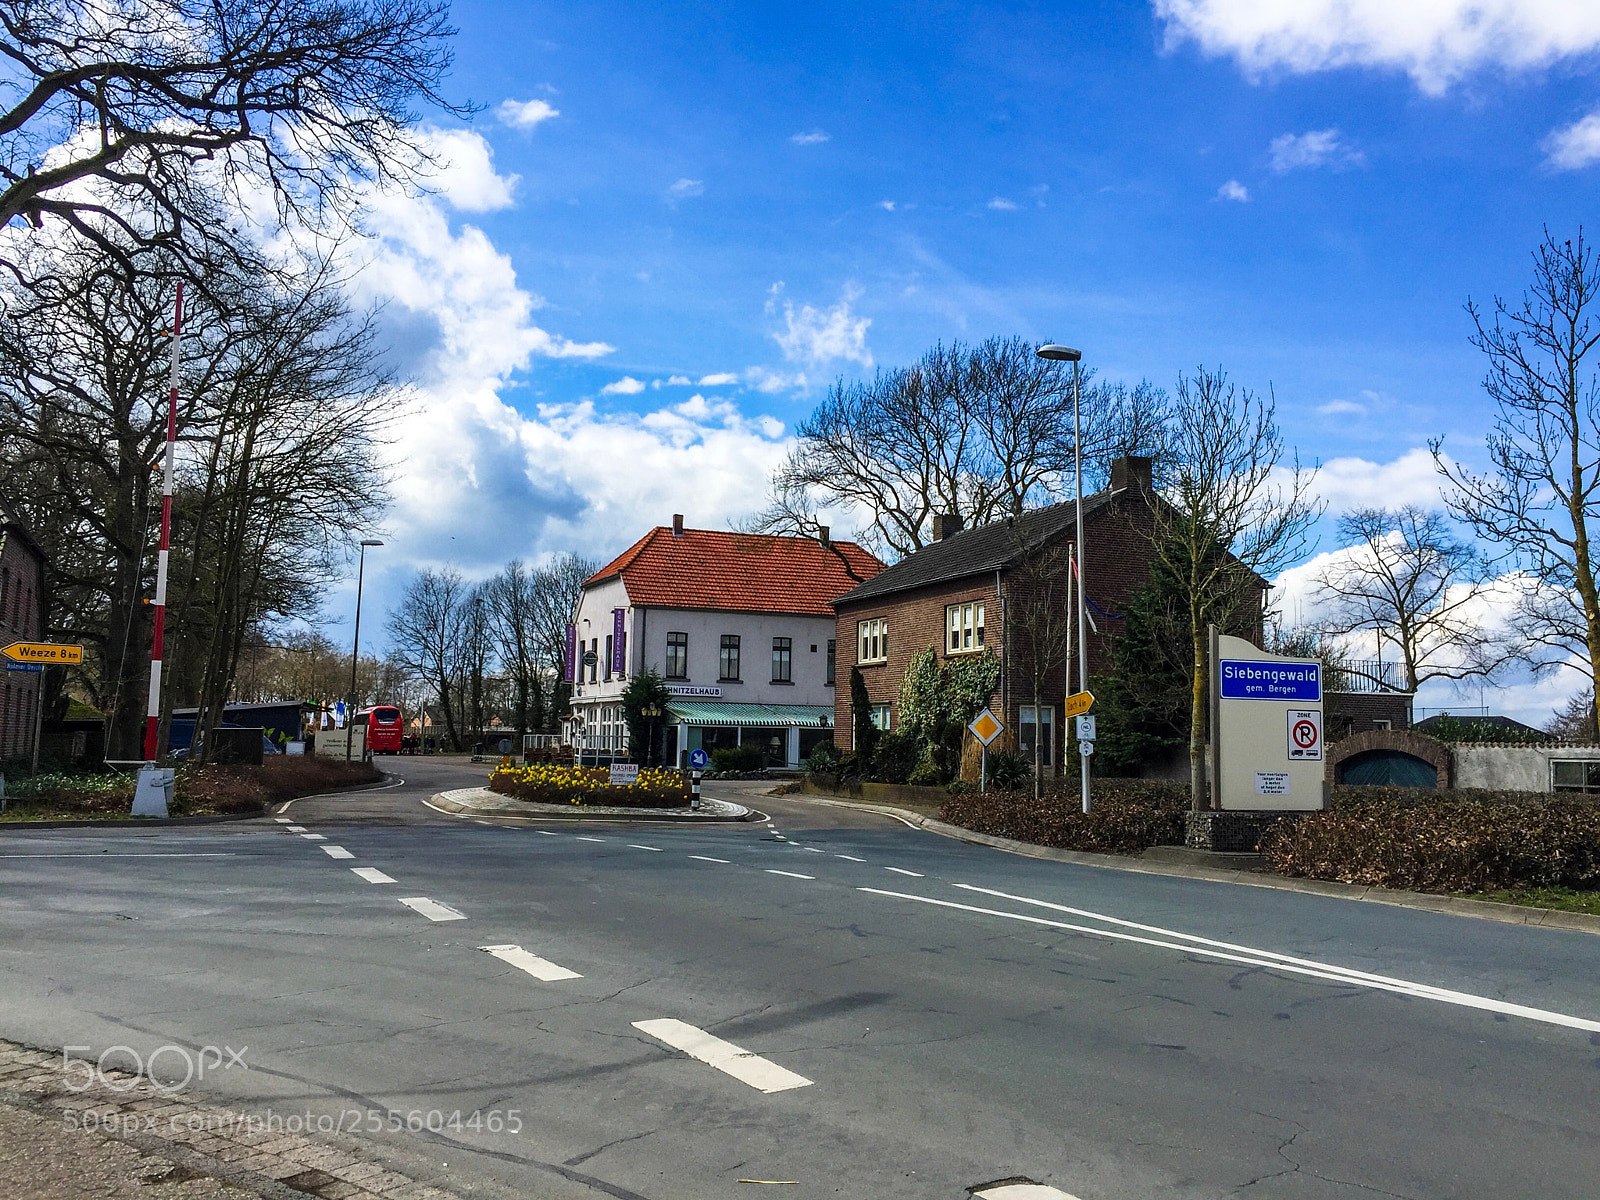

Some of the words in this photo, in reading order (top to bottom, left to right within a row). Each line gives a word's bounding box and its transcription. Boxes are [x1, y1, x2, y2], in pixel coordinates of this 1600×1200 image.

[19, 647, 56, 658] Weeze
[60, 649, 67, 658] 8
[68, 651, 79, 659] km
[1224, 666, 1317, 684] Siebengewald
[667, 686, 720, 696] HNITZELHAUS
[1246, 685, 1265, 694] gem.
[1268, 684, 1297, 695] Bergen
